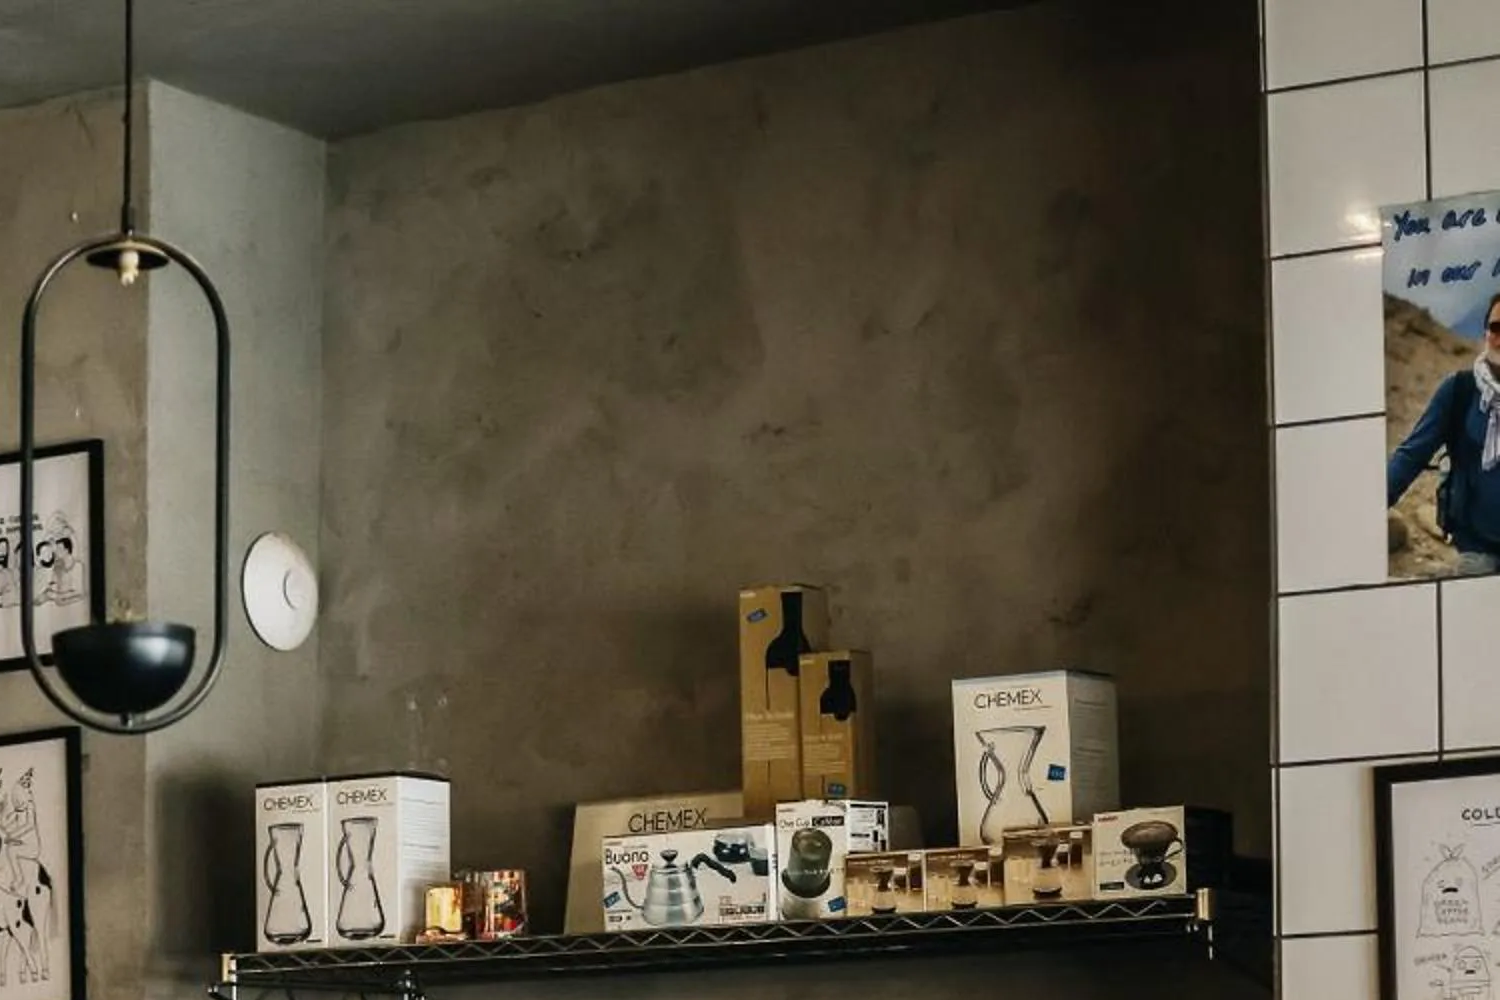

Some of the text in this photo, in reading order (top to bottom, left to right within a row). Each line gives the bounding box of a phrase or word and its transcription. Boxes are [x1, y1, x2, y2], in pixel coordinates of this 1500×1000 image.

[1441, 207, 1487, 230] are
[973, 688, 1044, 709] CHEMEX
[263, 794, 314, 811] CHEMEX
[336, 788, 388, 806] CHEMEX
[627, 807, 708, 834] CHEMEX
[605, 848, 649, 865] Buono
